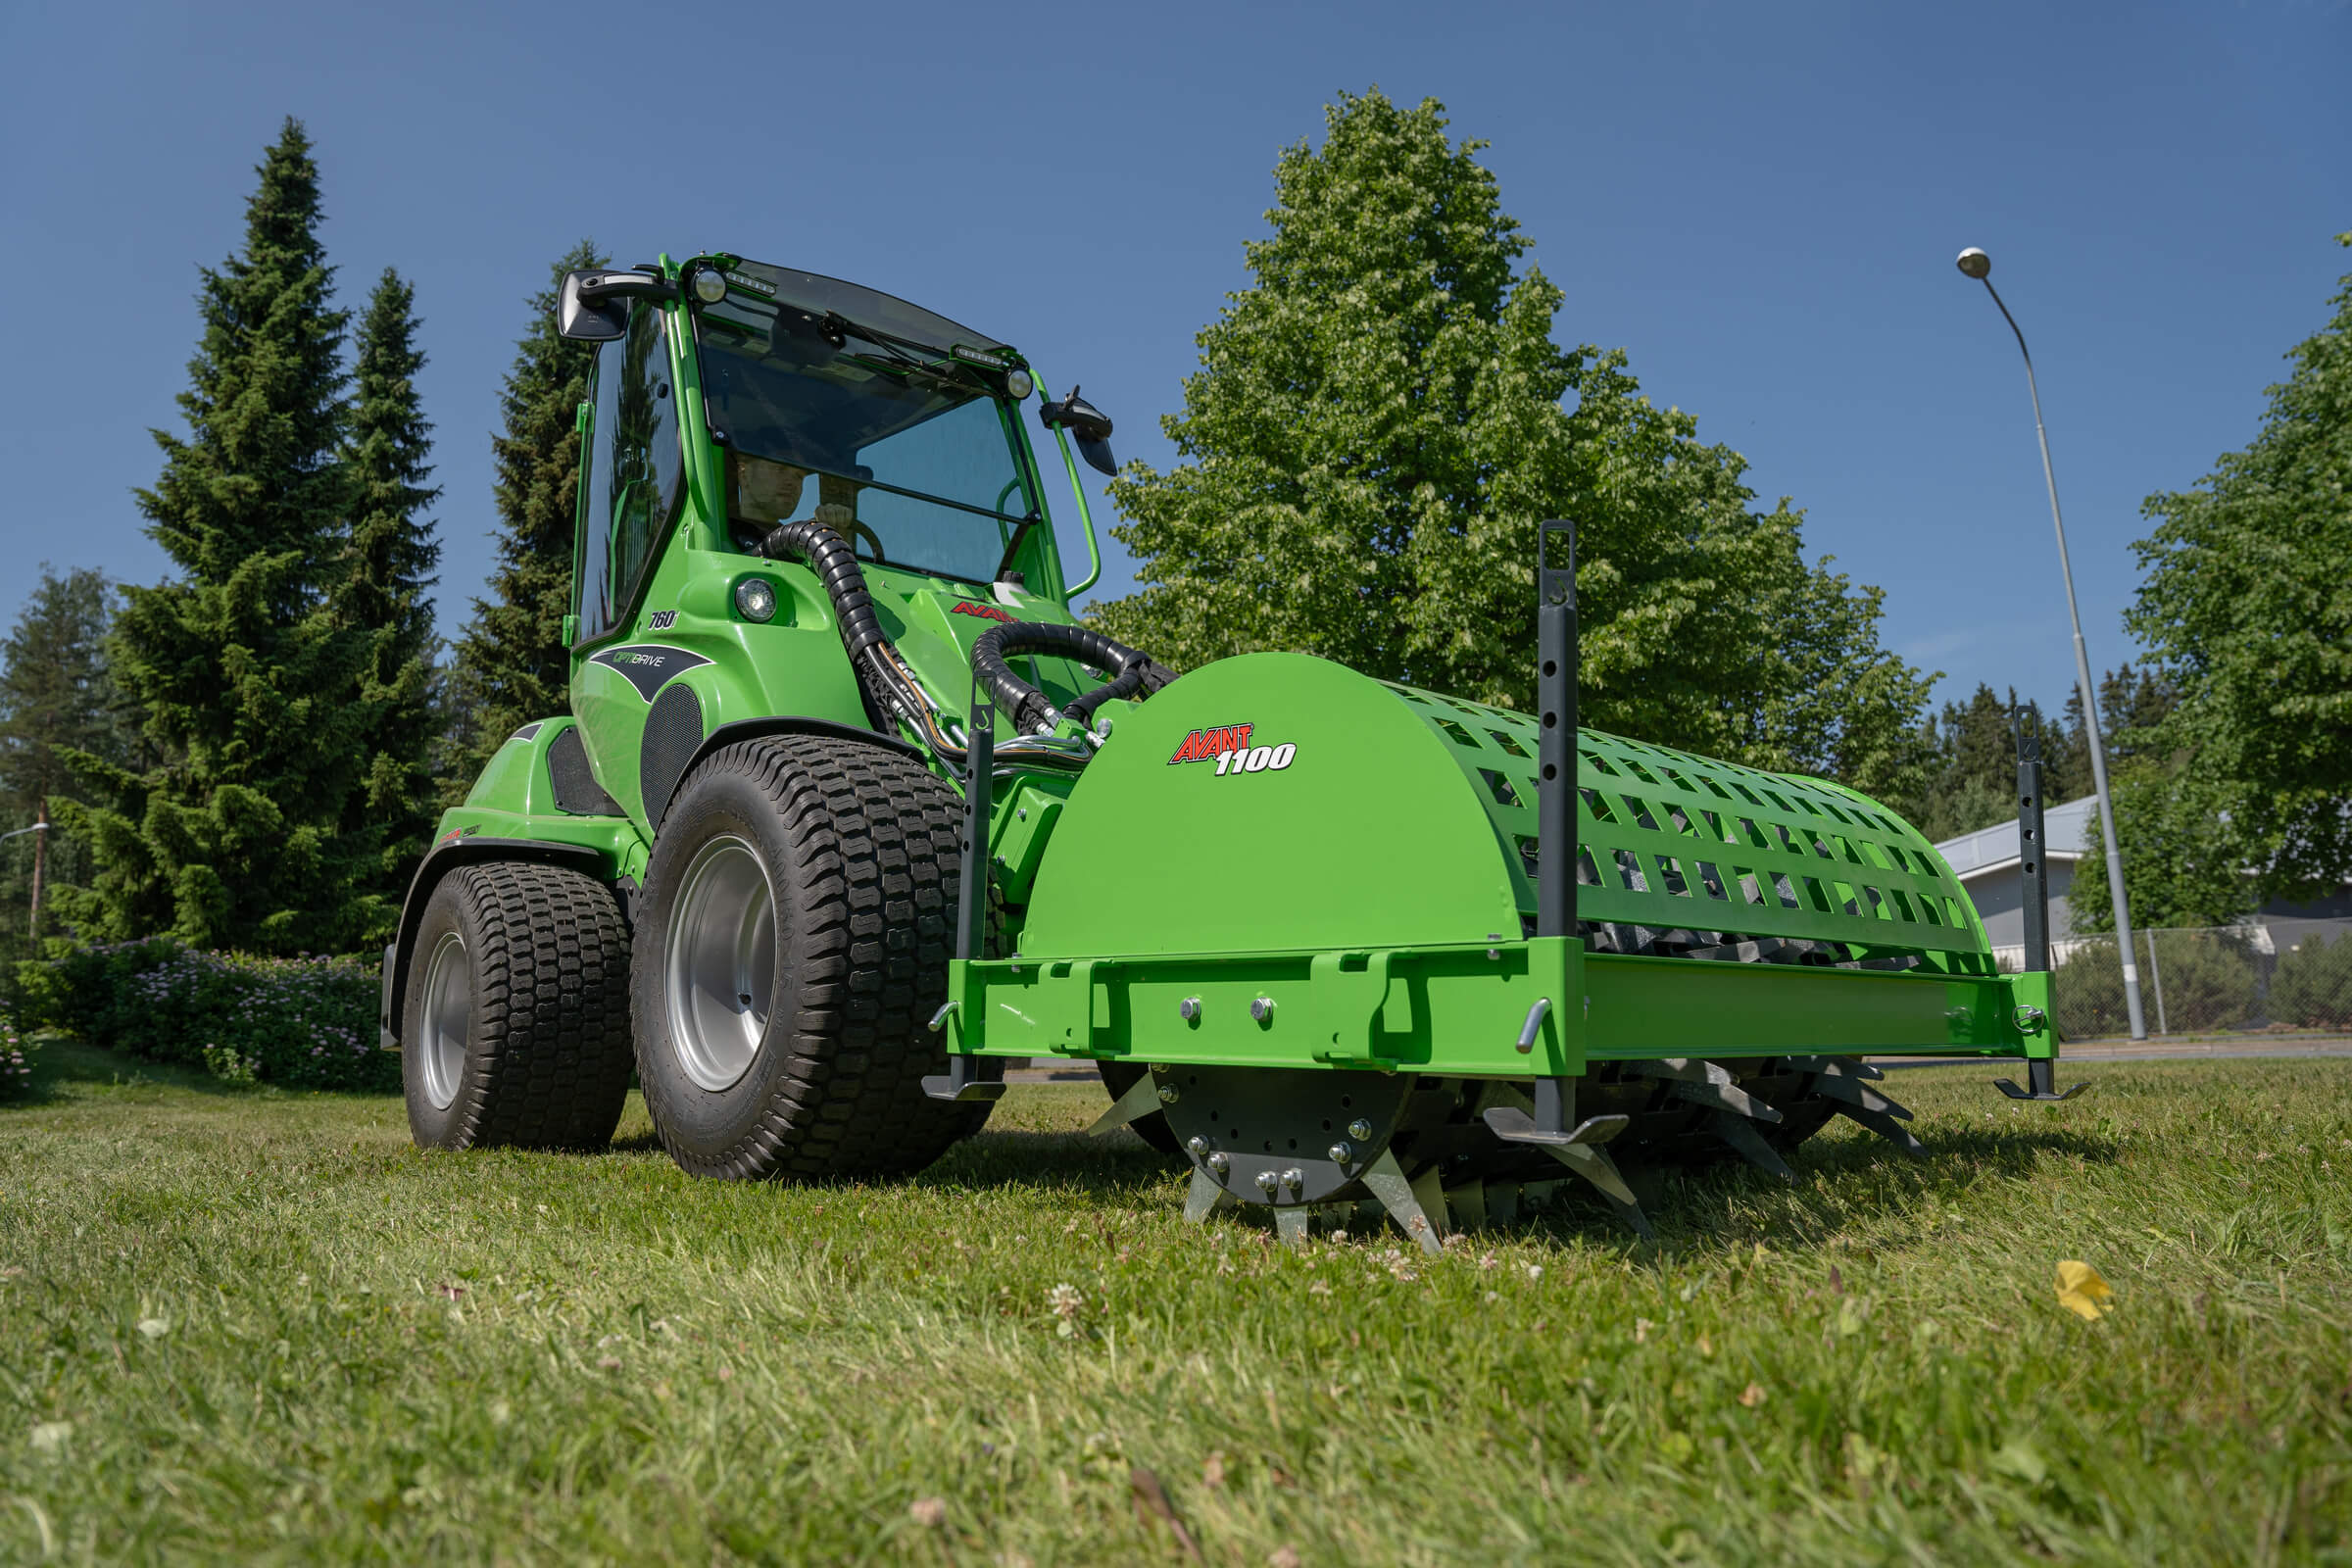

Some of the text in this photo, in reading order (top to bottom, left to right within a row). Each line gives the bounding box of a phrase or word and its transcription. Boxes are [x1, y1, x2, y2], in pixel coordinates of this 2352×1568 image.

[612, 651, 665, 667] OPTIDRIVE
[1167, 722, 1253, 765] AVANT
[1215, 742, 1298, 777] 1100
